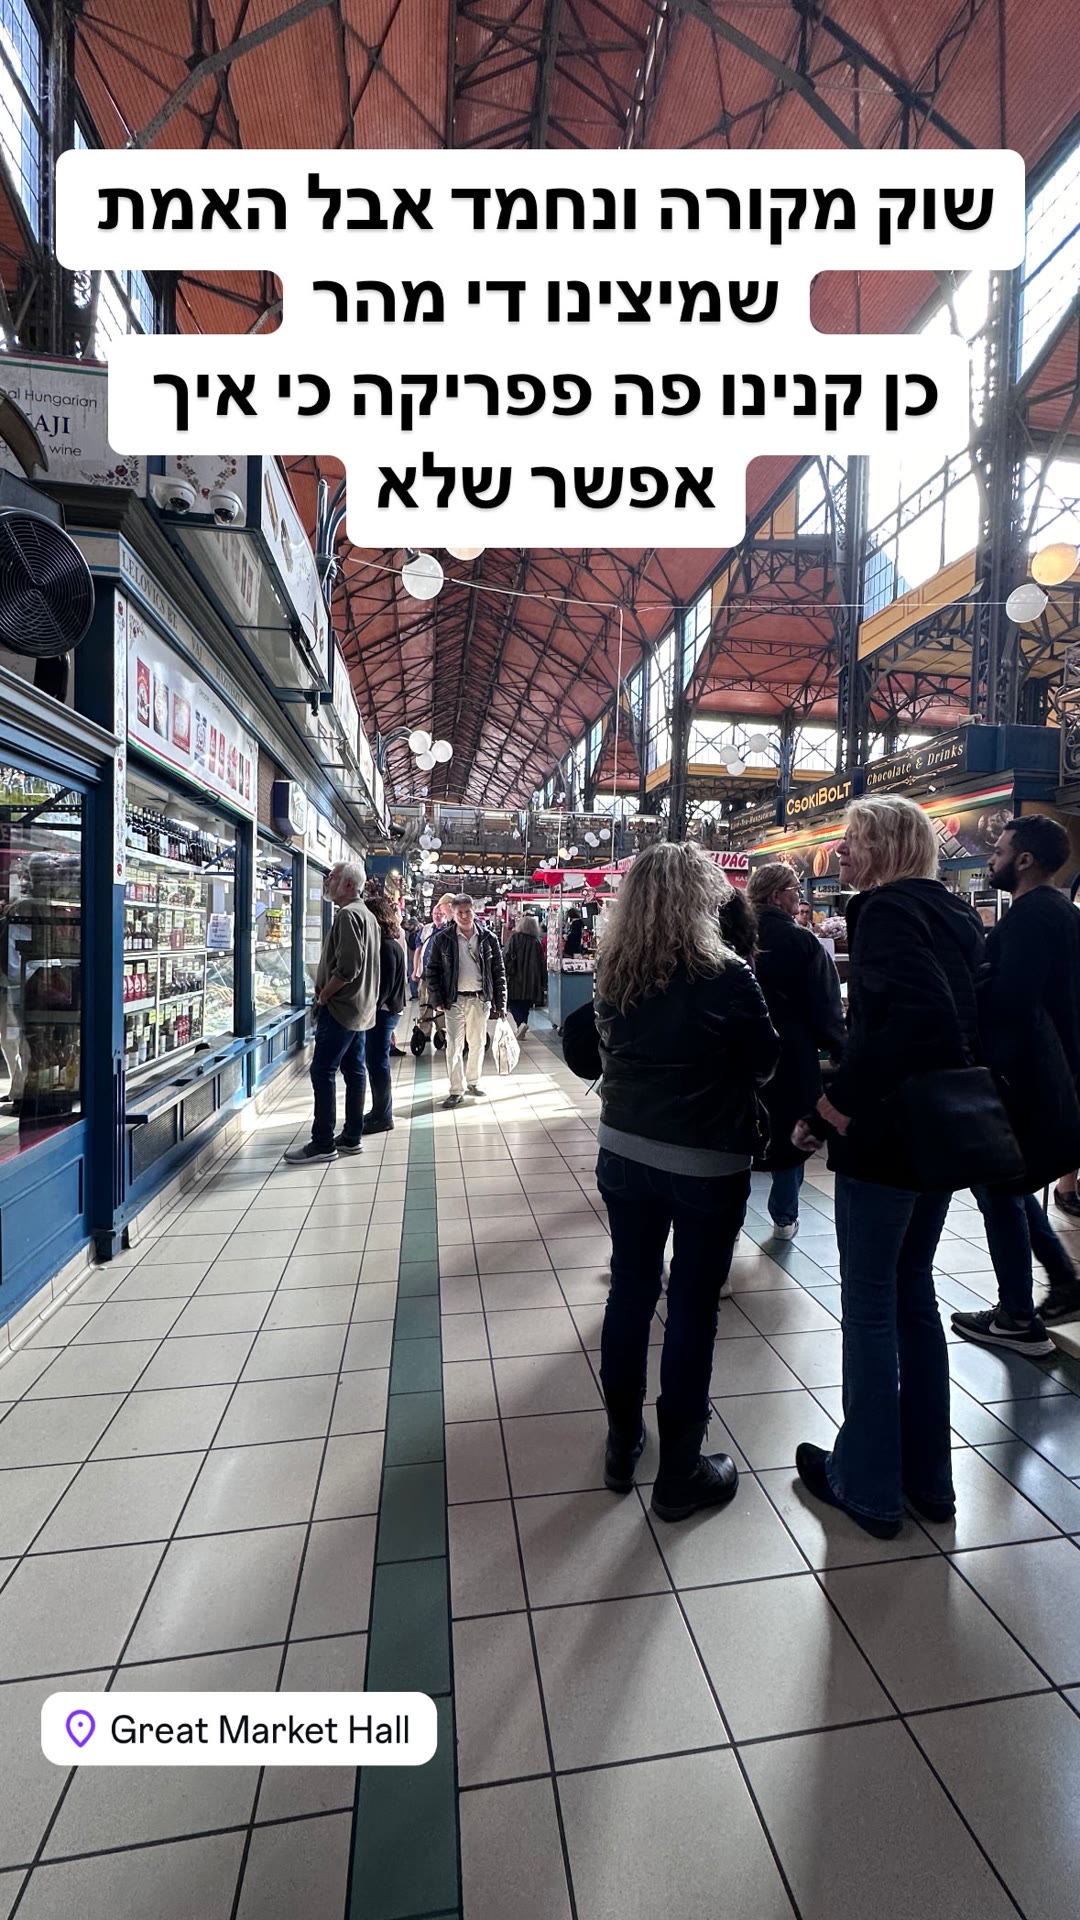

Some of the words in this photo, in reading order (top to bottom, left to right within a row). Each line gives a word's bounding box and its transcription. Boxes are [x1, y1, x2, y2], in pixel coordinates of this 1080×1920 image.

[25, 388, 97, 408] Hungarian
[29, 413, 70, 438] AJI
[49, 443, 82, 457] wine
[122, 550, 165, 616] LELOVICS
[866, 761, 912, 786] Chocolate
[915, 756, 923, 770] &
[927, 743, 964, 766] Drinks
